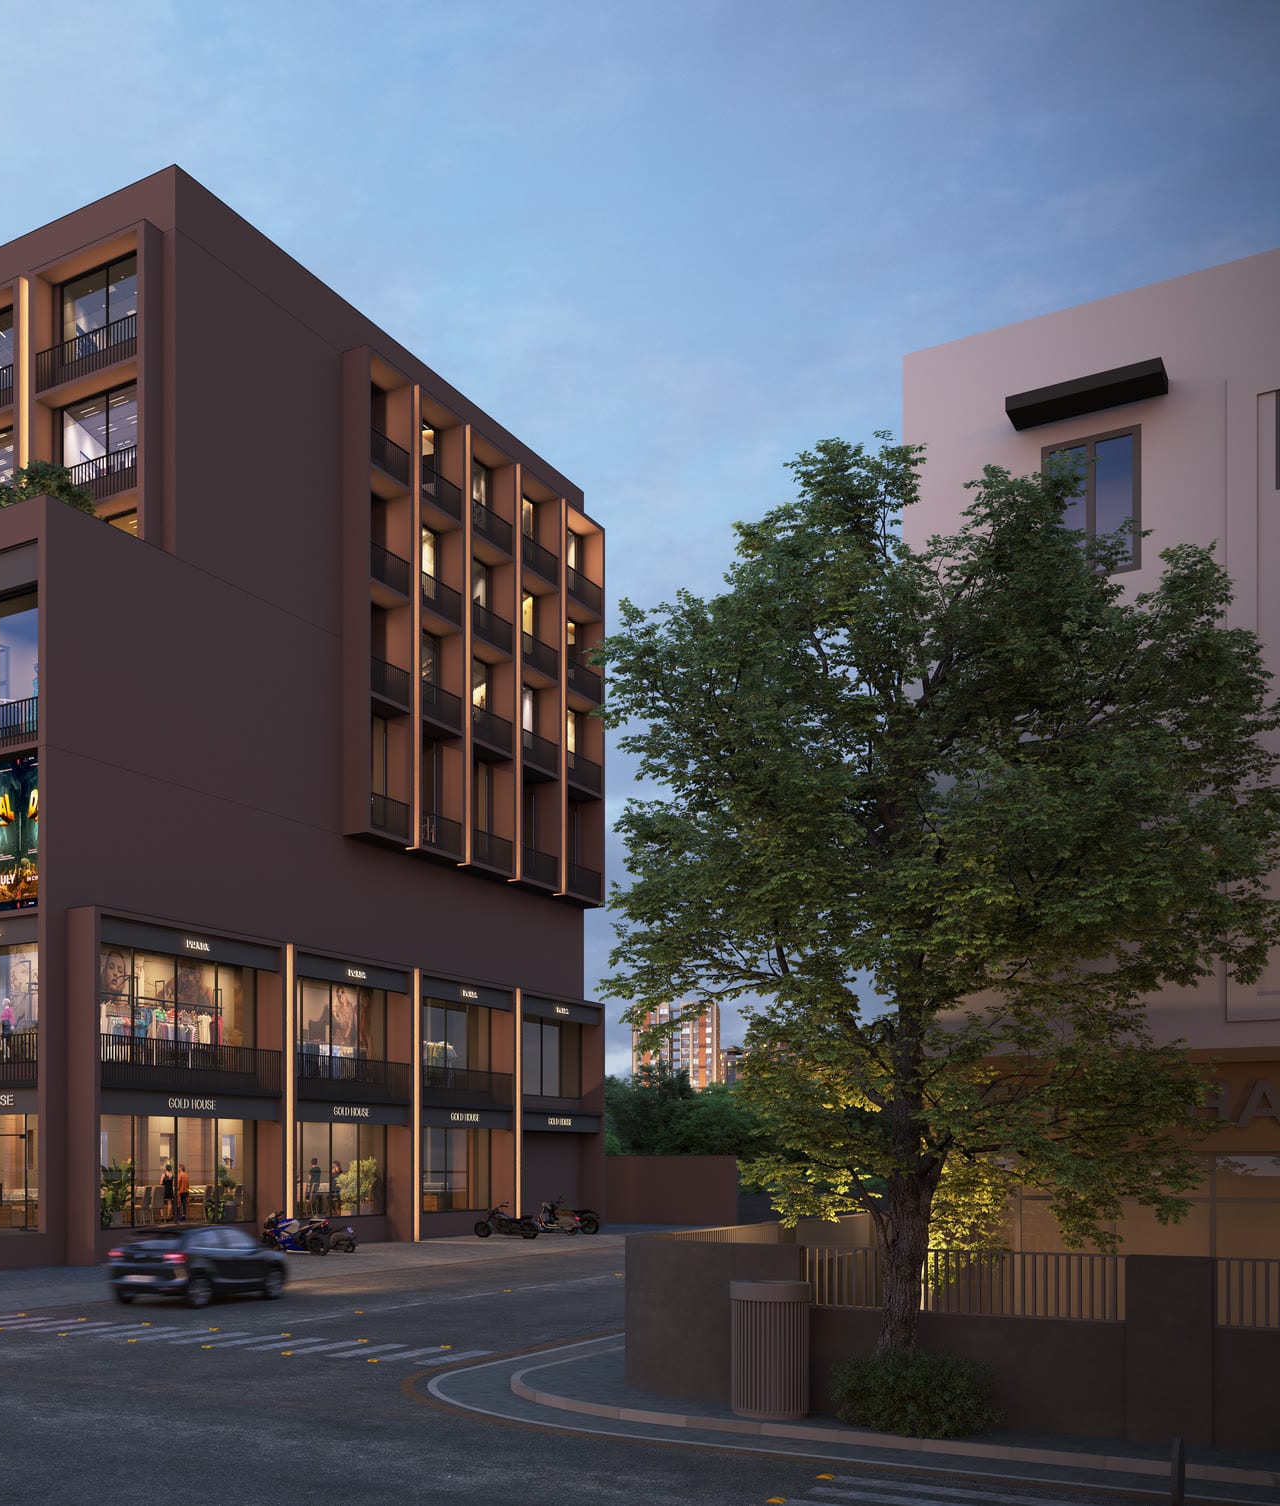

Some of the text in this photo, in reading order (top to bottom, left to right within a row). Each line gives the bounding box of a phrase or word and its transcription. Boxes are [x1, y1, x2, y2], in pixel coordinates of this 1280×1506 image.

[168, 1097, 217, 1111] GOLD HOUSE
[333, 1106, 371, 1118] GOLD HOUSE
[450, 1112, 464, 1121] GOLD
